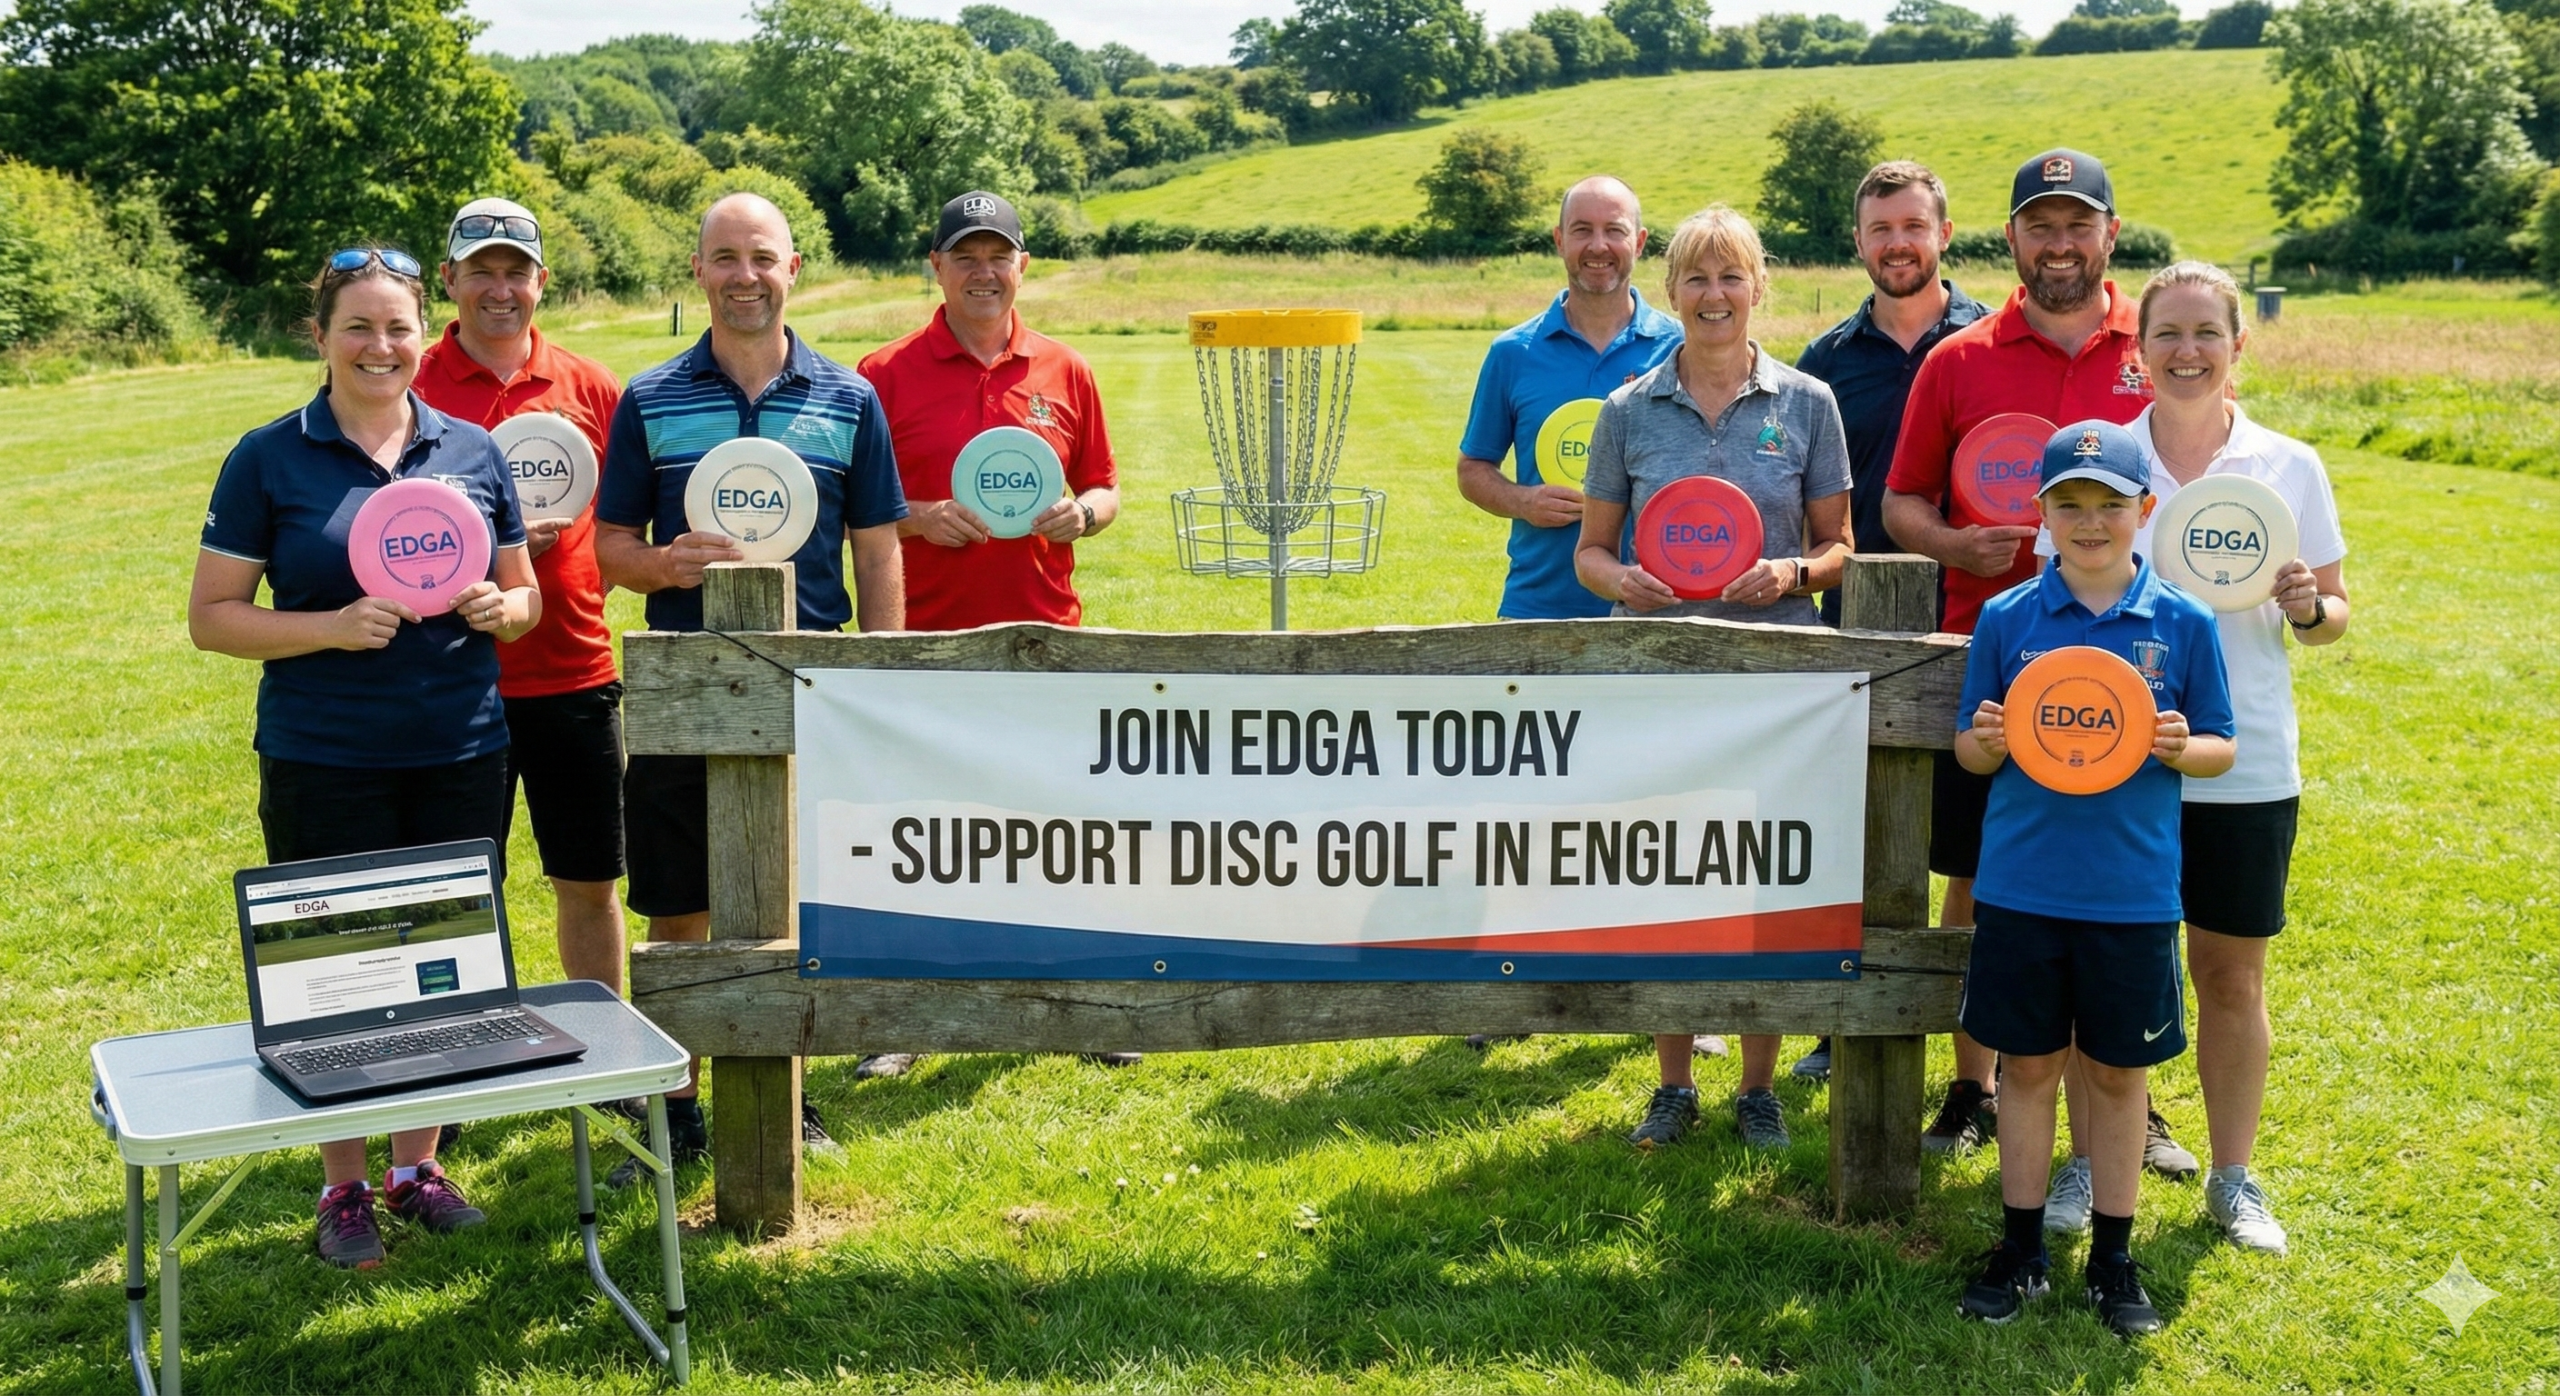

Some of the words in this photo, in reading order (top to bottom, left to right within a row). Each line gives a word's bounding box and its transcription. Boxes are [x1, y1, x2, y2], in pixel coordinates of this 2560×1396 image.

[1560, 440, 1590, 457] ED
[508, 459, 569, 478] EDGA
[1980, 459, 2041, 481] EDGA
[980, 472, 1037, 489] EDGA
[717, 489, 785, 509] EDGA
[384, 530, 457, 558] EDGA
[1665, 524, 1730, 543] EDGA
[2189, 528, 2261, 551] EDGA
[2040, 705, 2117, 730] EDGA
[1089, 708, 1210, 776] JOIN
[1231, 709, 1380, 776] EDGA
[1396, 709, 1582, 776] TODAY
[851, 846, 873, 857] -
[891, 816, 1152, 886] SUPPORT
[1170, 819, 1298, 887] DISC
[1316, 820, 1457, 887] GOLF
[1475, 821, 1529, 886] IN
[1550, 819, 1813, 886] ENGLAND
[294, 900, 330, 914] EDGA
